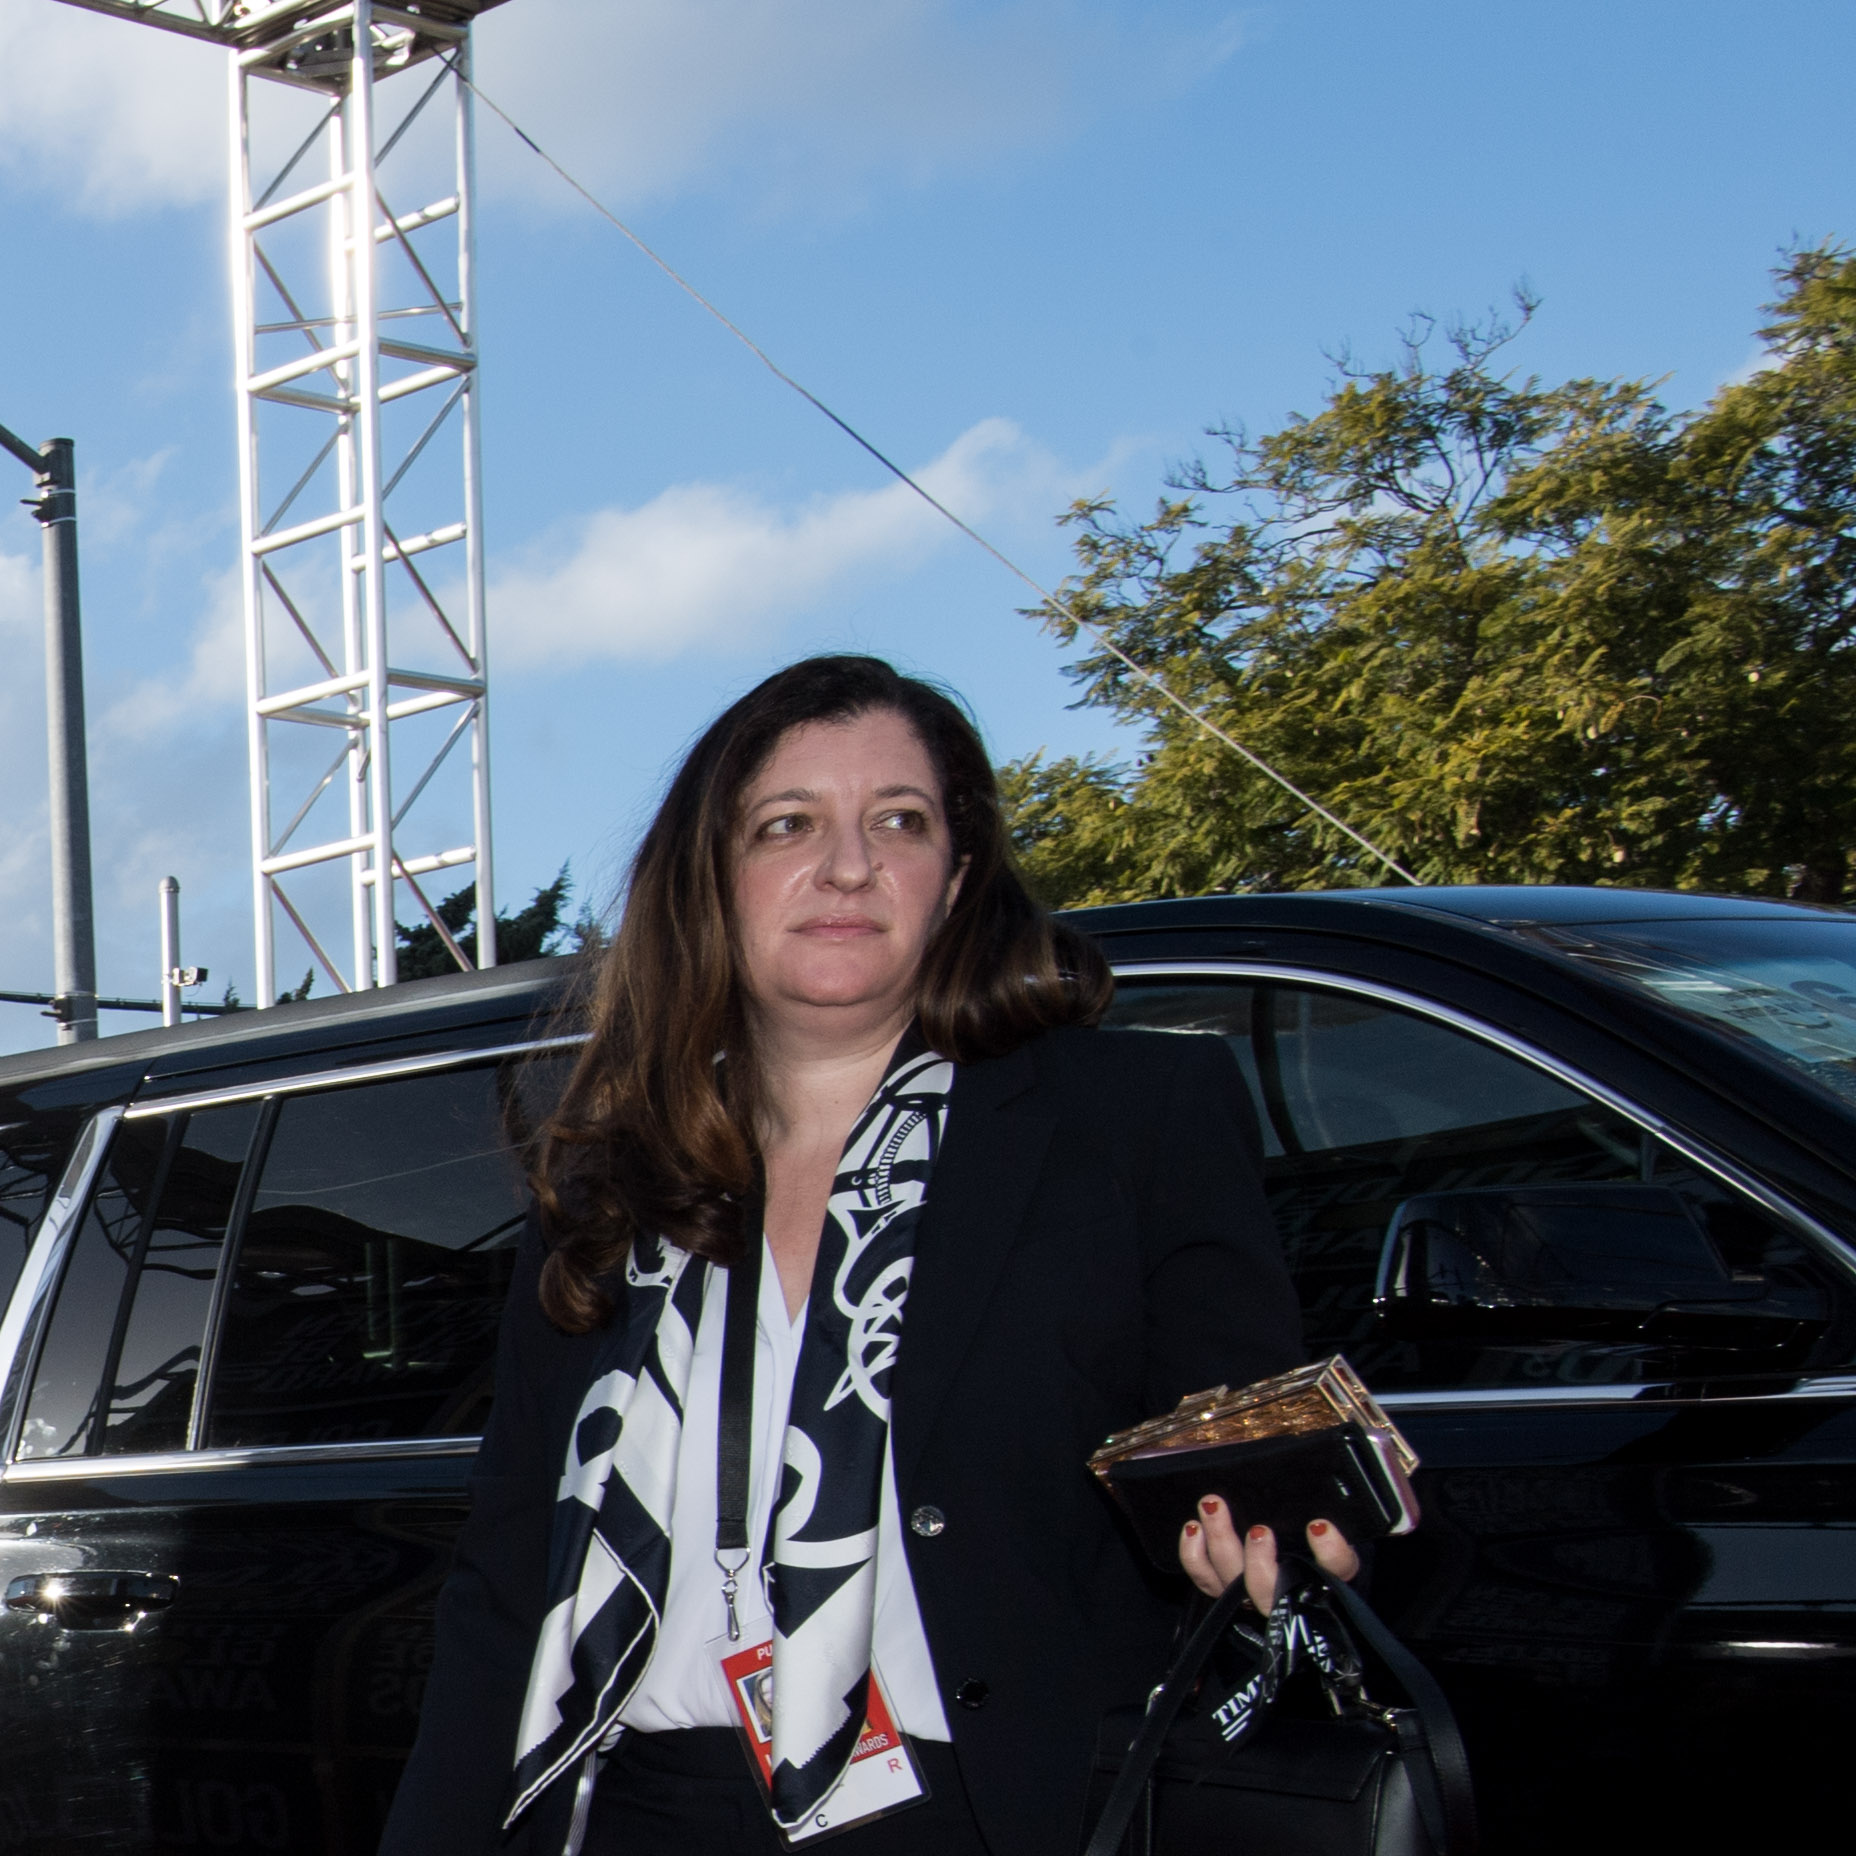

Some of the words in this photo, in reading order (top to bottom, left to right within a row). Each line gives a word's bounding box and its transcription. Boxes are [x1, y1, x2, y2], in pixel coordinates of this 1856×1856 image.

[1212, 1674, 1263, 1726] TIM
[887, 1757, 903, 1773] R
[815, 1814, 828, 1828] C
